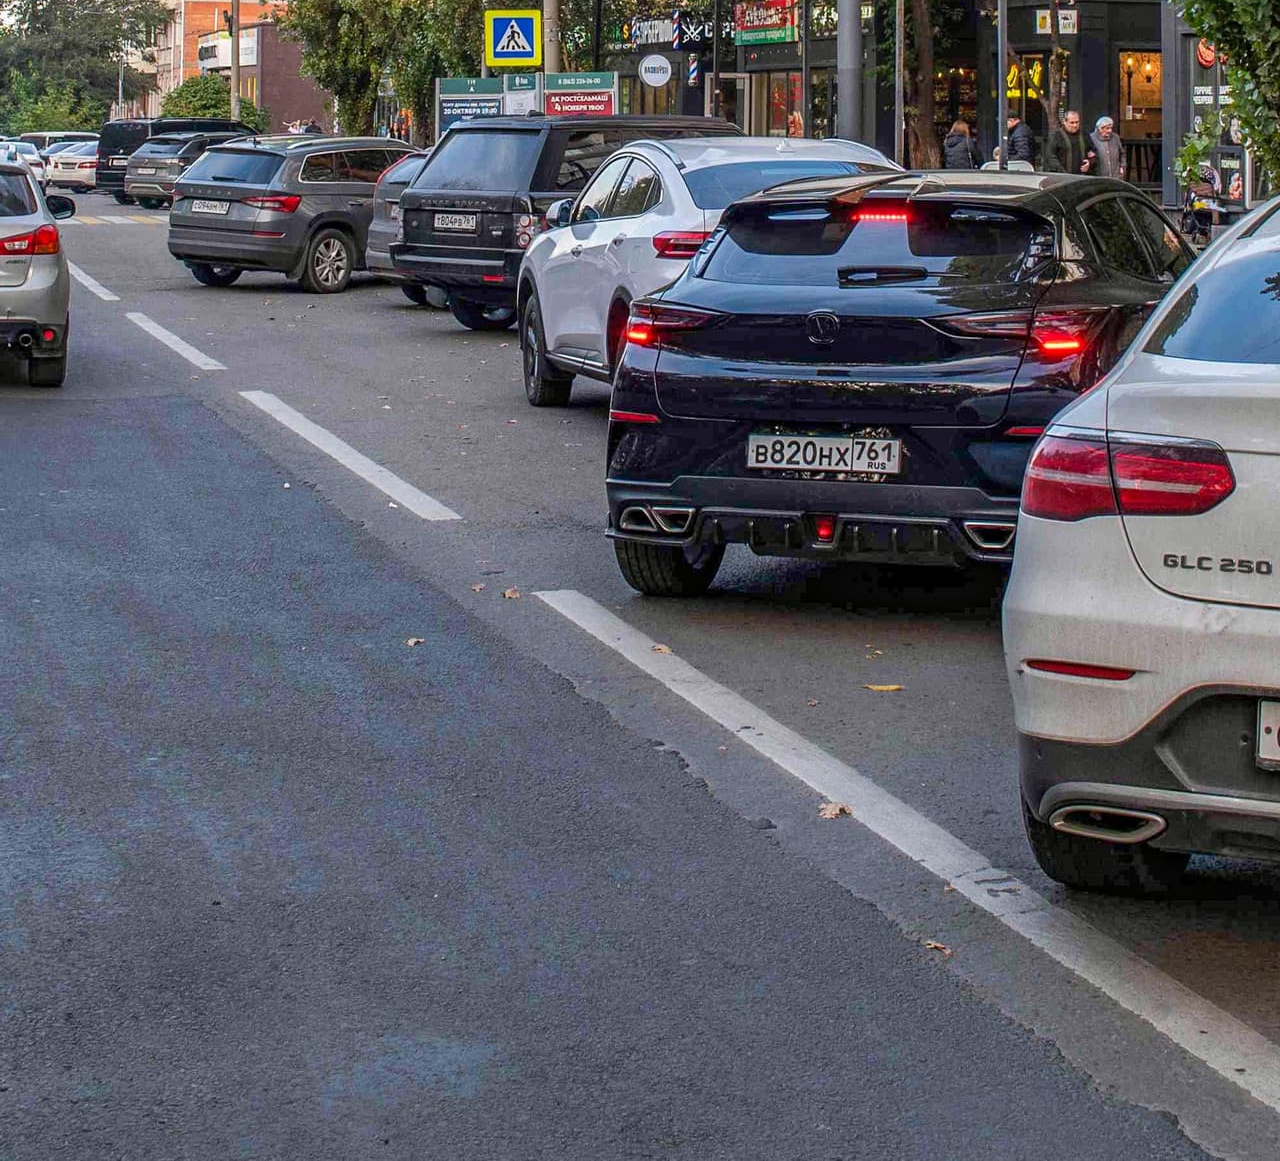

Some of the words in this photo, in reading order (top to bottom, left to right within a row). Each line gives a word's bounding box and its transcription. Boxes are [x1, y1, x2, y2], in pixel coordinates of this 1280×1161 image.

[755, 440, 850, 467] В820НХ
[855, 441, 893, 463] 761
[867, 462, 887, 470] RUS
[1163, 554, 1213, 571] GLC
[1219, 558, 1273, 576] 250
